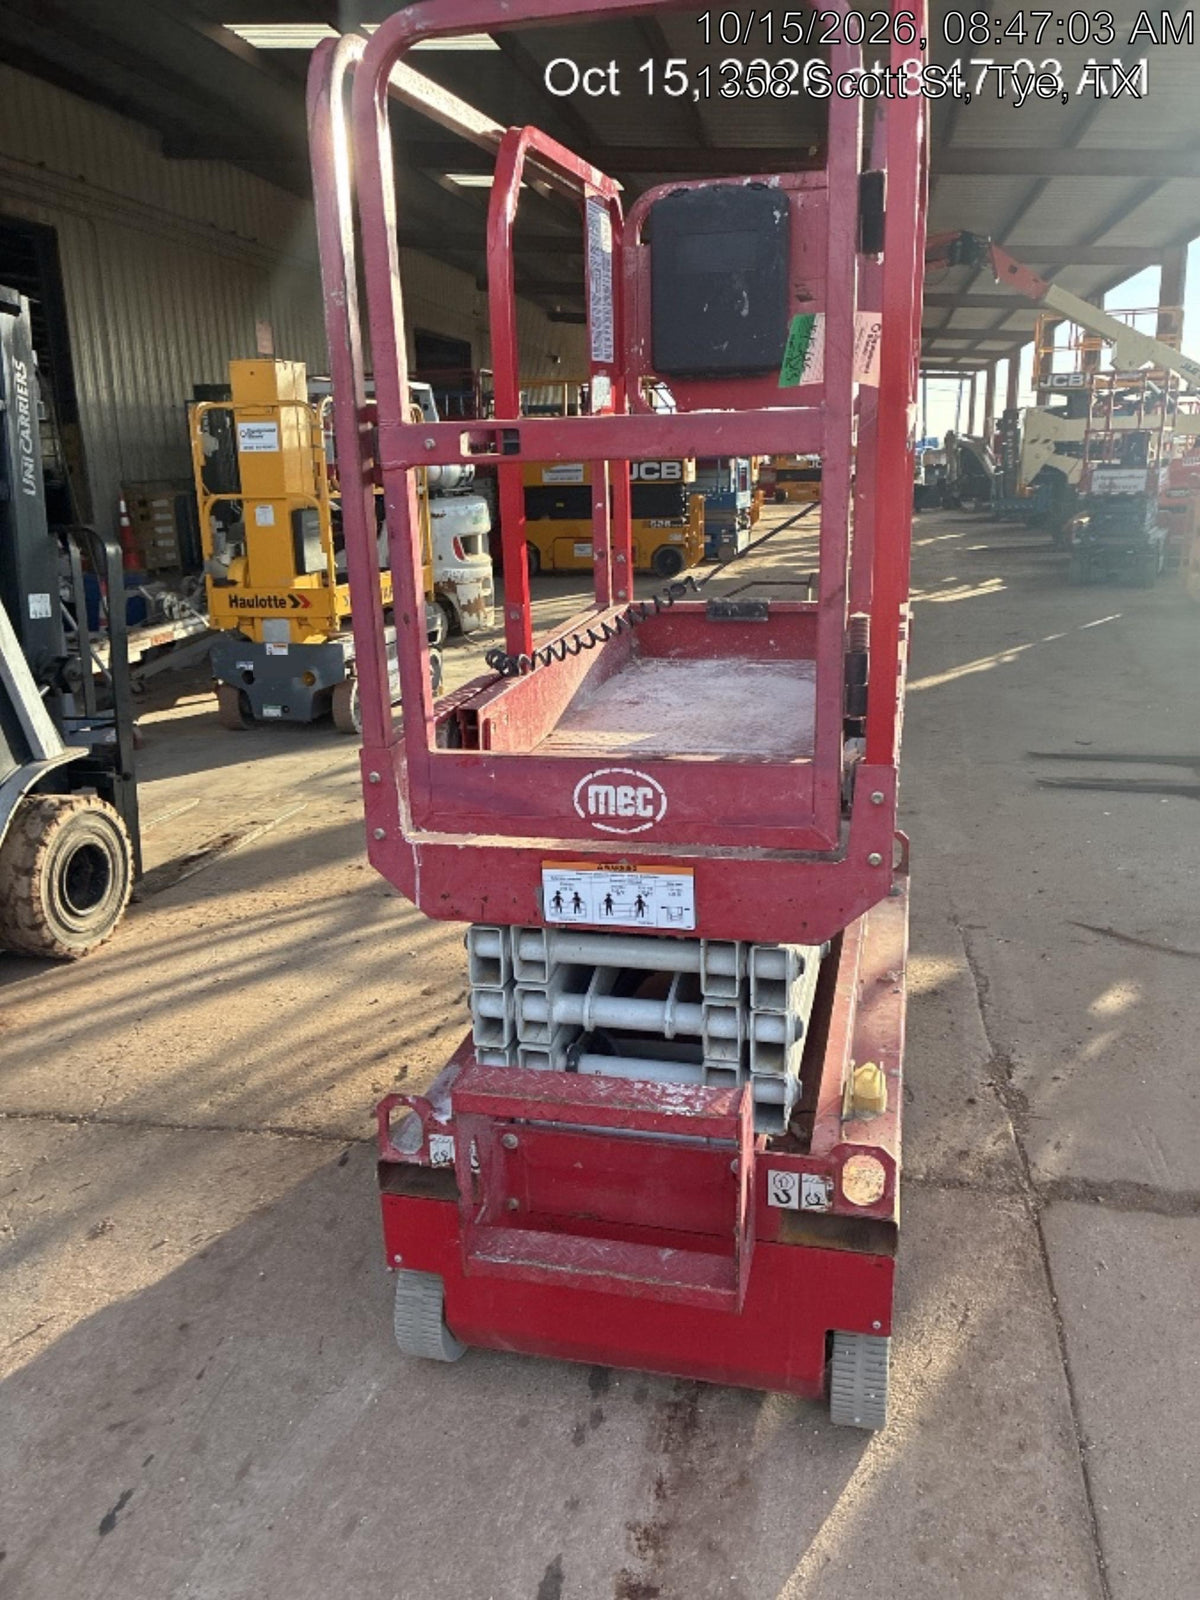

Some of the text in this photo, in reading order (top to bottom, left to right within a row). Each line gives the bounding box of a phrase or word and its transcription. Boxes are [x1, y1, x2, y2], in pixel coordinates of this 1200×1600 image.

[1040, 374, 1083, 388] JCB
[630, 461, 682, 480] JCB
[228, 594, 287, 609] Haulotte
